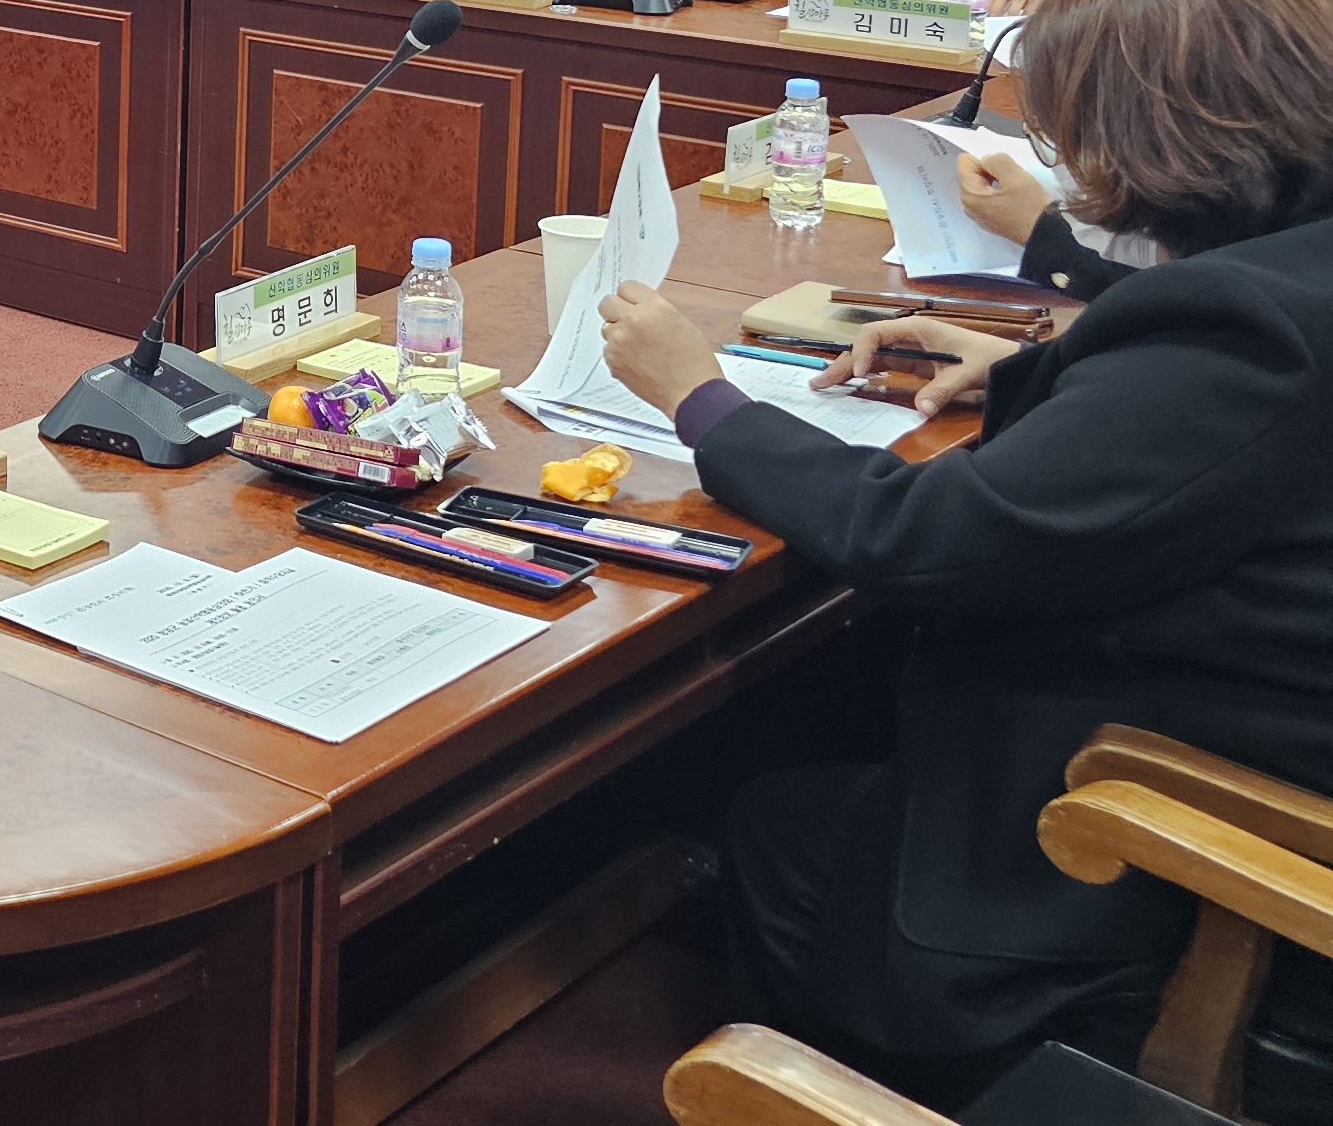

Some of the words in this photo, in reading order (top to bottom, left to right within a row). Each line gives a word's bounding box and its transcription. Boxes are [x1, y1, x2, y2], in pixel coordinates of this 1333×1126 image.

[853, 12, 946, 42] 김미숙
[268, 261, 341, 299] 산학협동심의위원
[270, 285, 338, 337] 명문희
